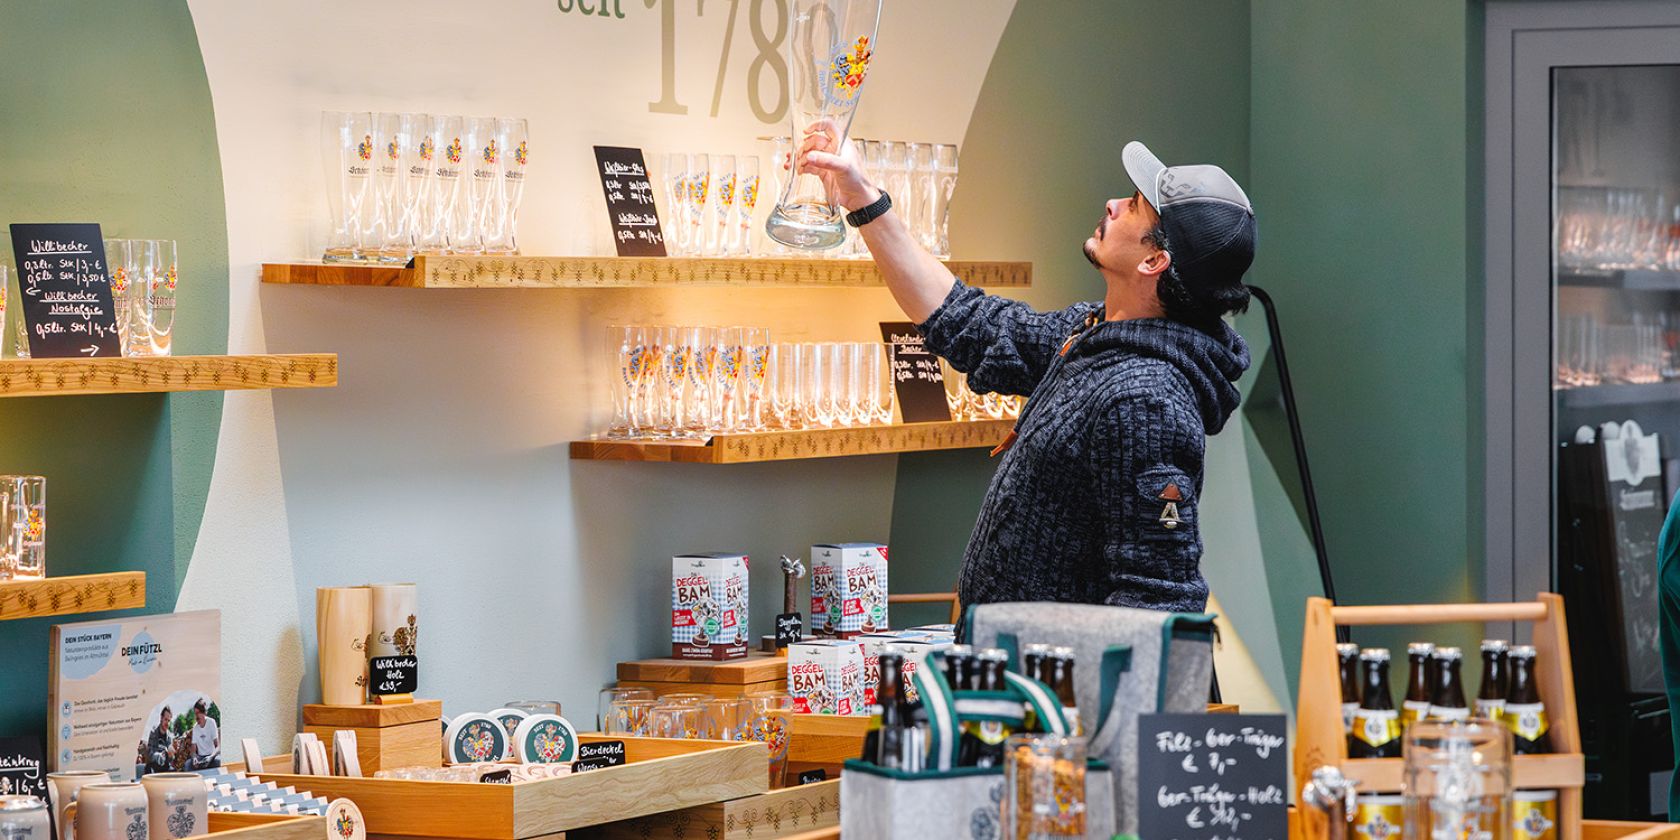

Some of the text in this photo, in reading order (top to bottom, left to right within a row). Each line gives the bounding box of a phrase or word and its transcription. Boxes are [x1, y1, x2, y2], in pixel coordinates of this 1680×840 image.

[30, 240, 88, 253] Willibecher
[45, 290, 97, 301] Willibecher
[51, 303, 102, 320] Nostalgie
[814, 574, 834, 591] BAM
[848, 574, 877, 593] BAM
[678, 585, 711, 604] BAM
[121, 642, 162, 657] DEIN FÜTZL
[793, 672, 826, 692] BAM
[864, 666, 881, 682] BA
[580, 743, 624, 757] Bierdeckel
